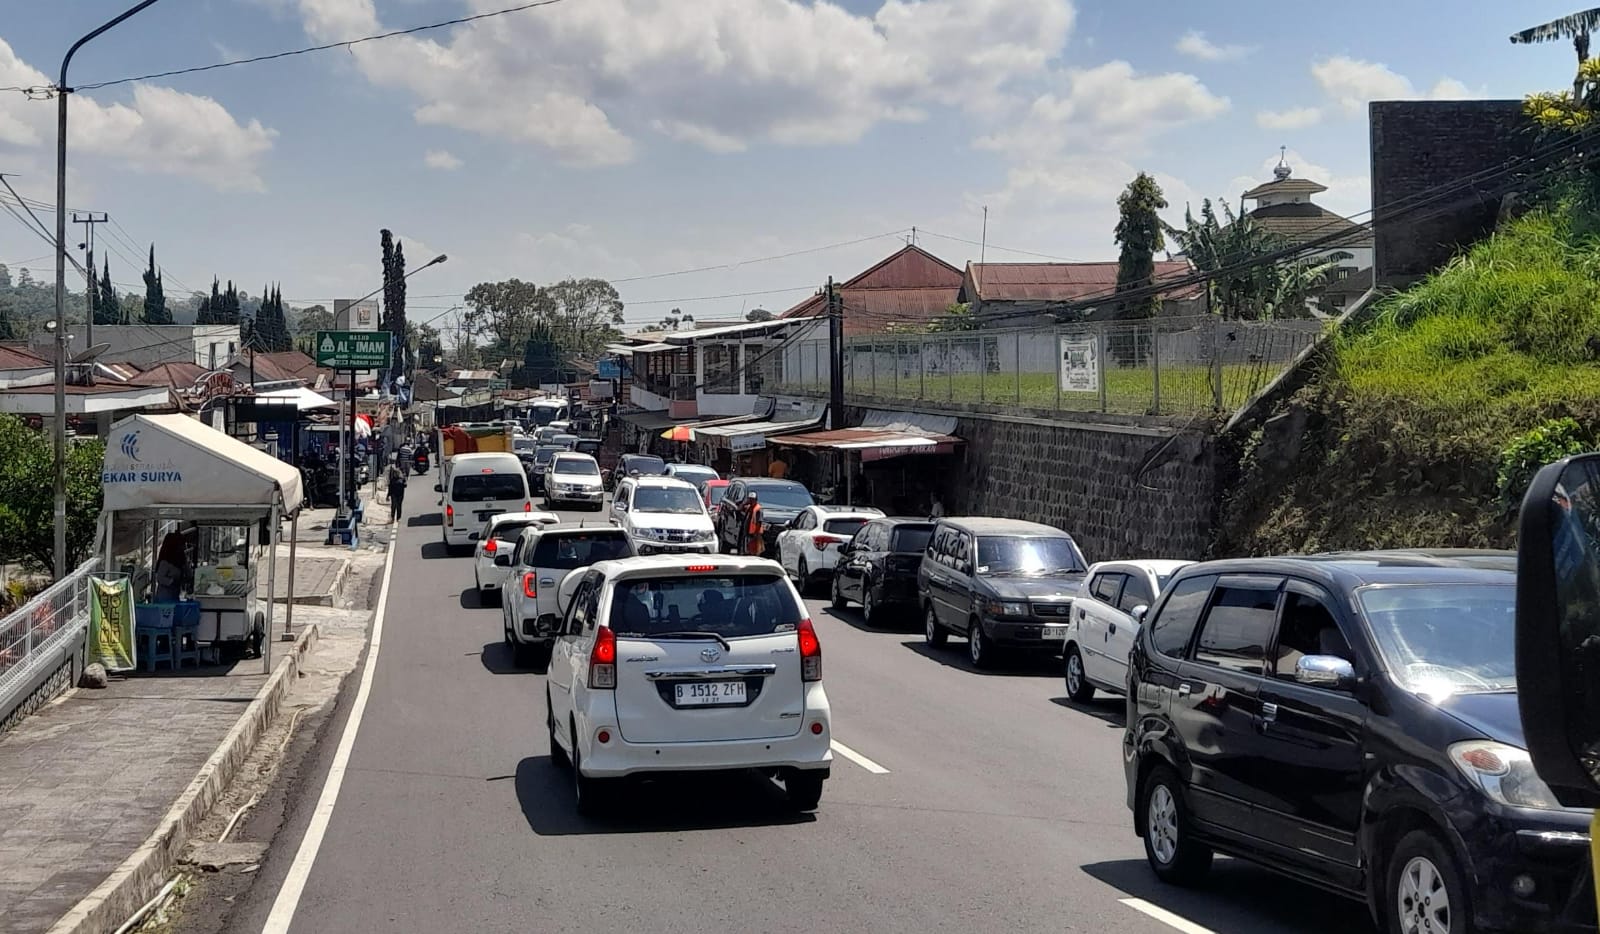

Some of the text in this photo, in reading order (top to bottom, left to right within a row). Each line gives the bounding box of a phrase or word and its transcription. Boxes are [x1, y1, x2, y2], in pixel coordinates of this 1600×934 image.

[140, 471, 182, 482] SURYA
[676, 683, 744, 698] B 1512 ZFH
